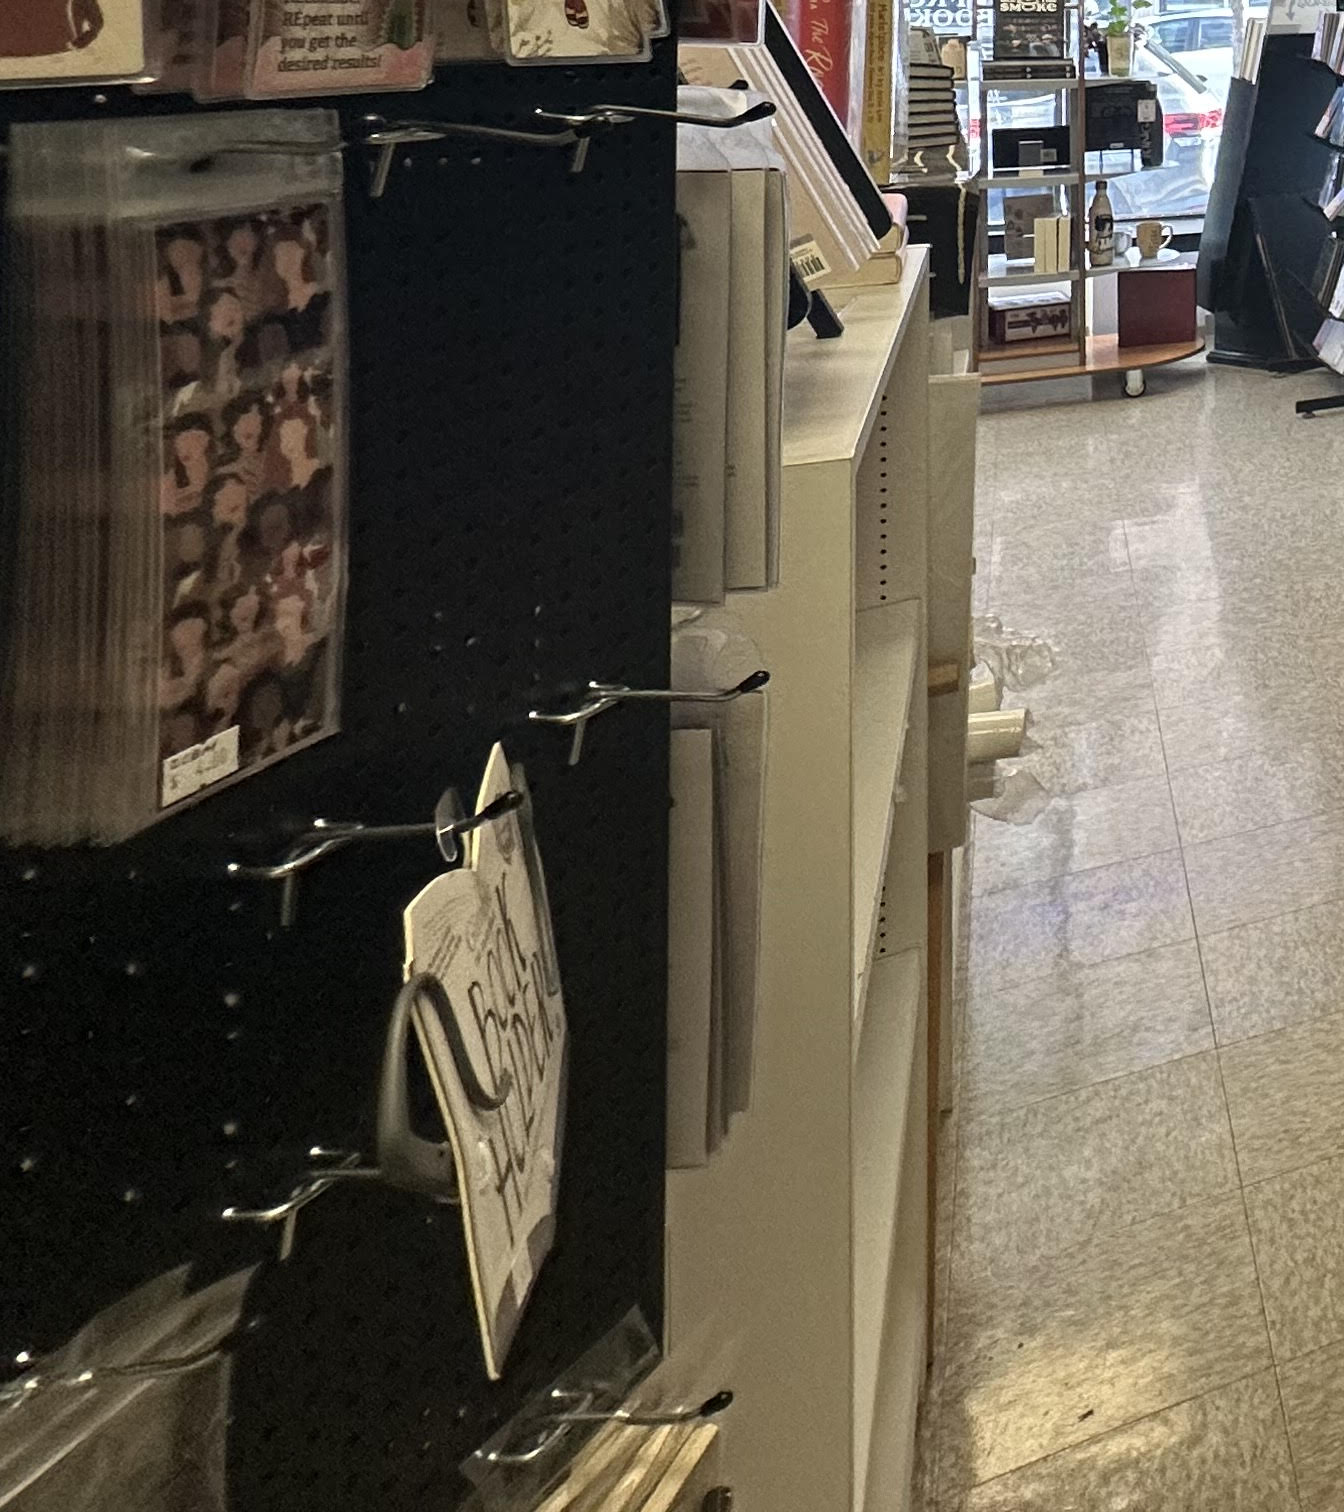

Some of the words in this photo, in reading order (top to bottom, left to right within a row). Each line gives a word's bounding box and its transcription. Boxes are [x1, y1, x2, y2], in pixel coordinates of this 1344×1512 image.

[999, 2, 1057, 13] SMOKE
[335, 32, 357, 48] the
[277, 57, 330, 72] desired
